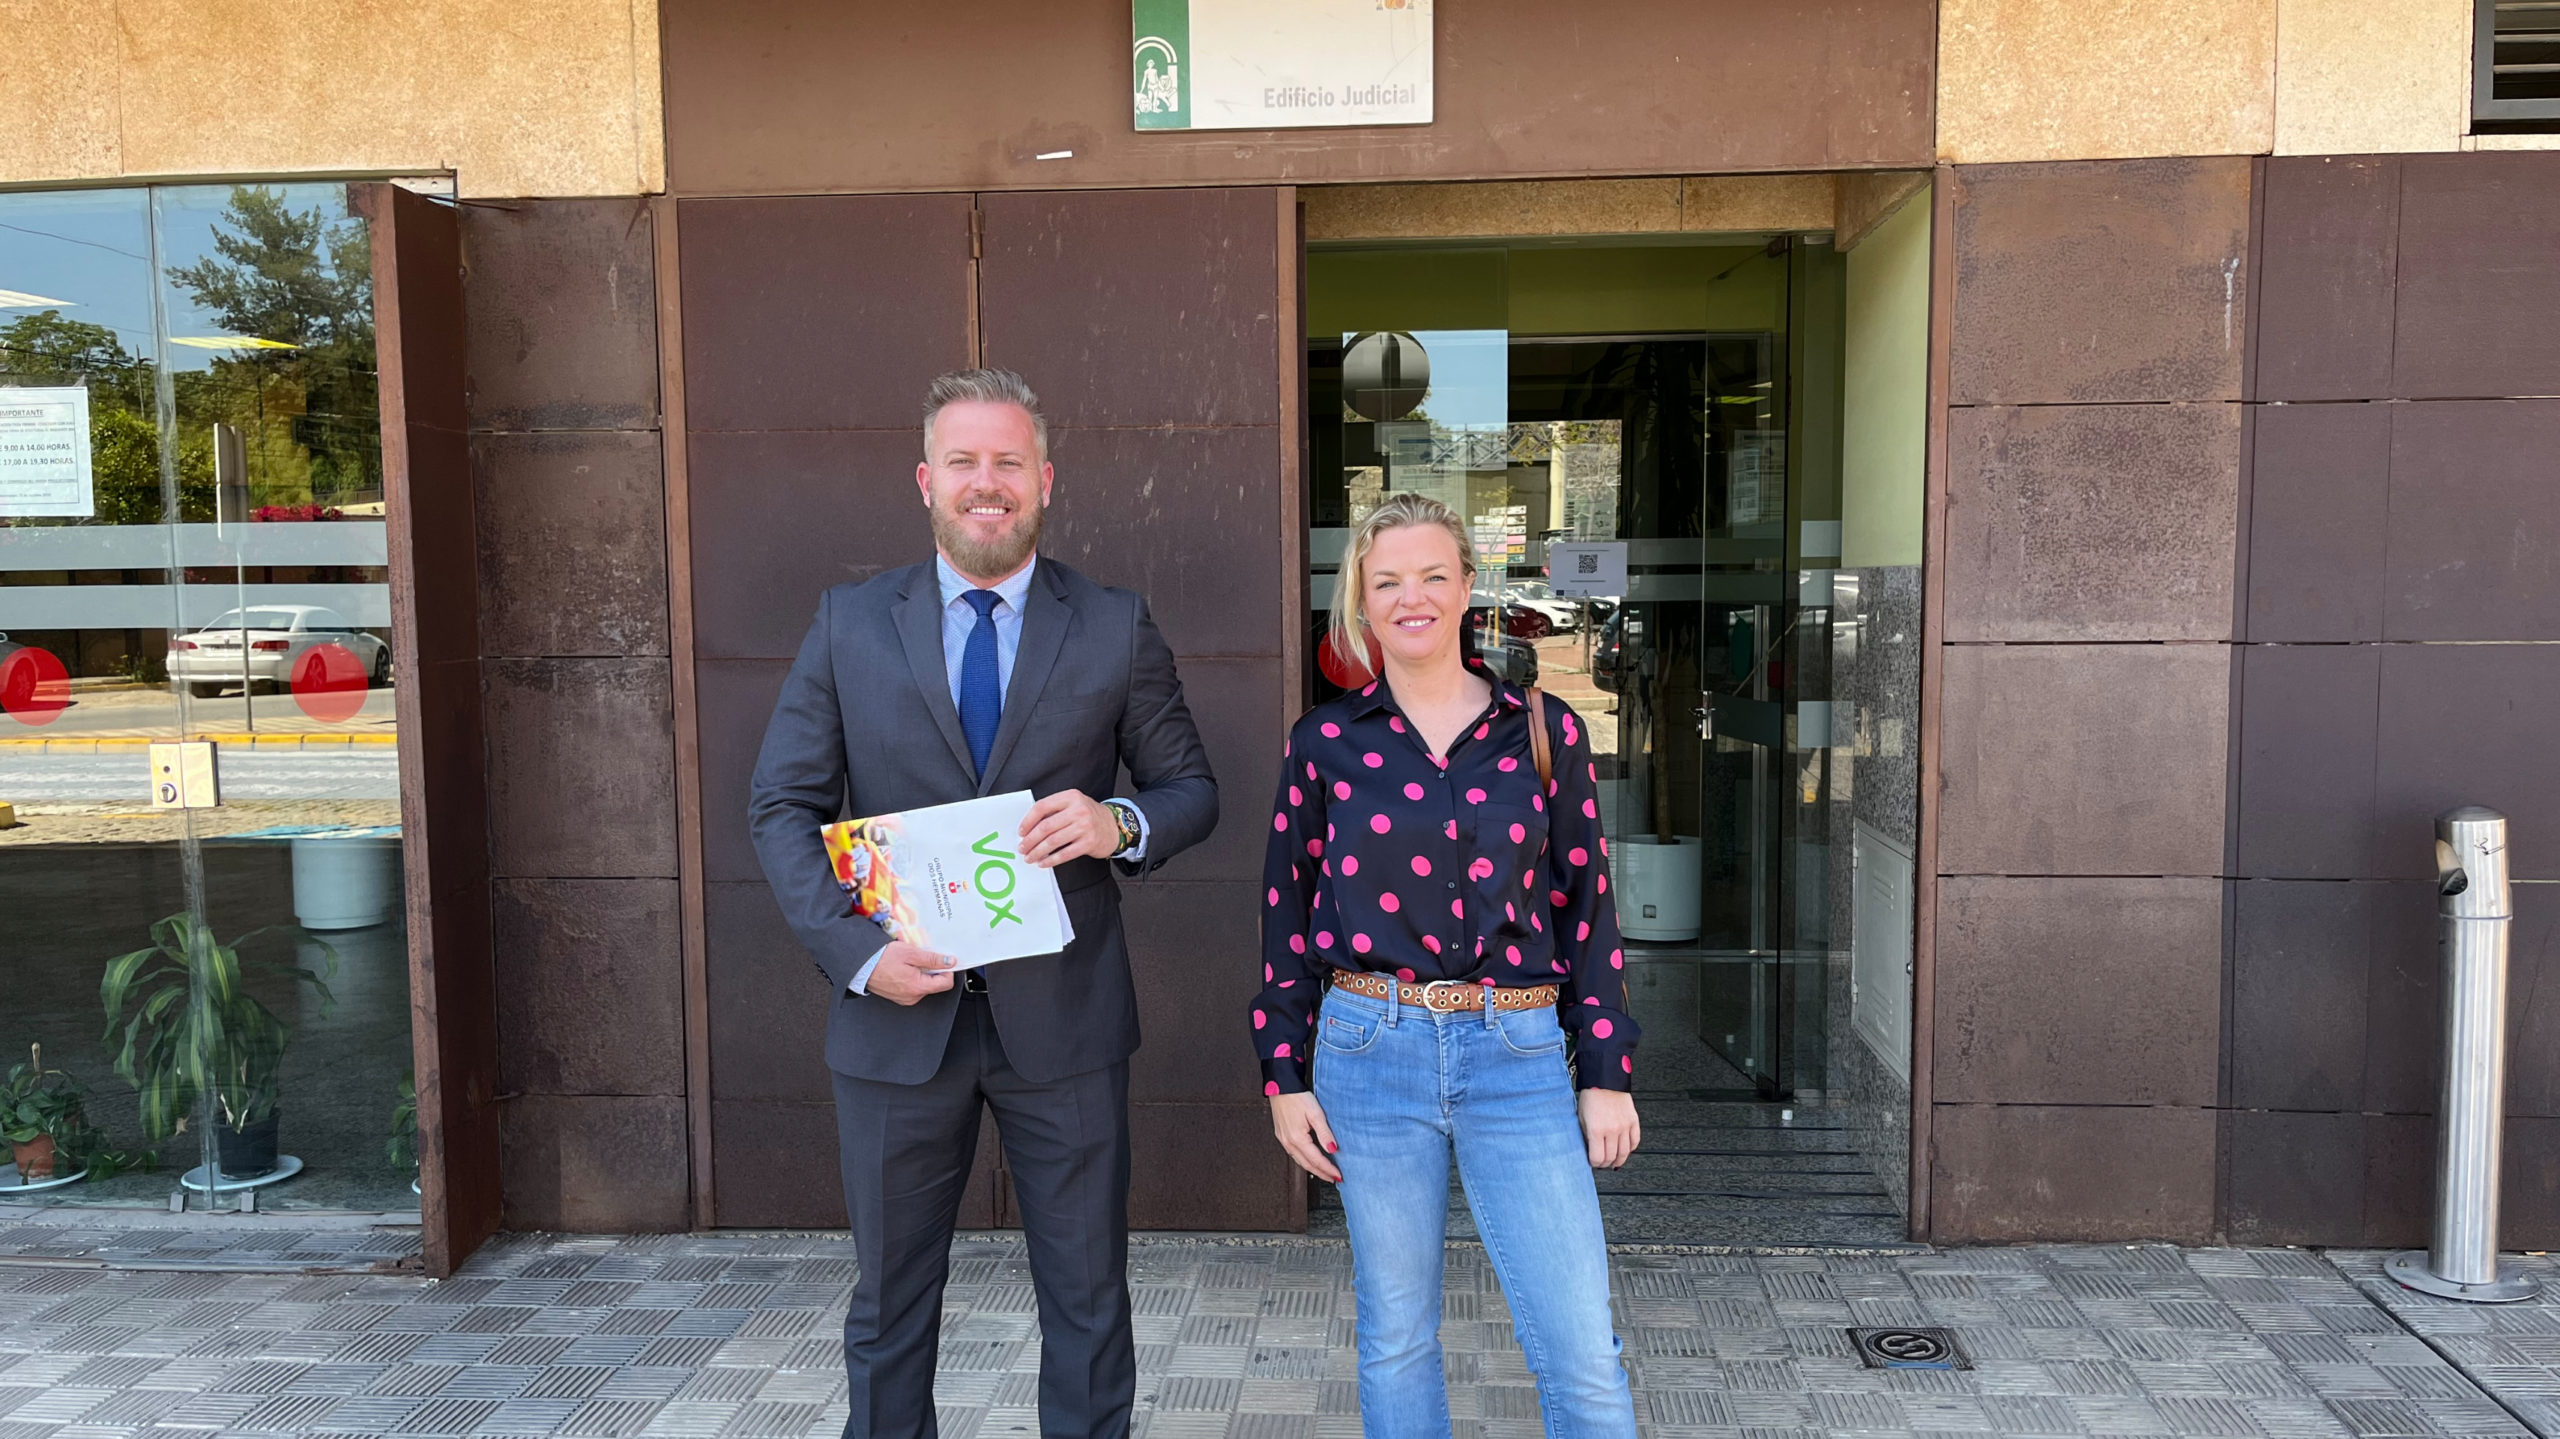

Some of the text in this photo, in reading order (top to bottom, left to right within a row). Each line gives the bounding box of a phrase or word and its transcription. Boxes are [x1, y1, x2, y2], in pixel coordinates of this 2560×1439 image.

[1263, 84, 1416, 109] Edificio Judicial
[927, 862, 946, 918] DOS HERMANAS
[933, 857, 953, 921] GRUPO MUNICIPAL
[971, 831, 1023, 929] VOX
